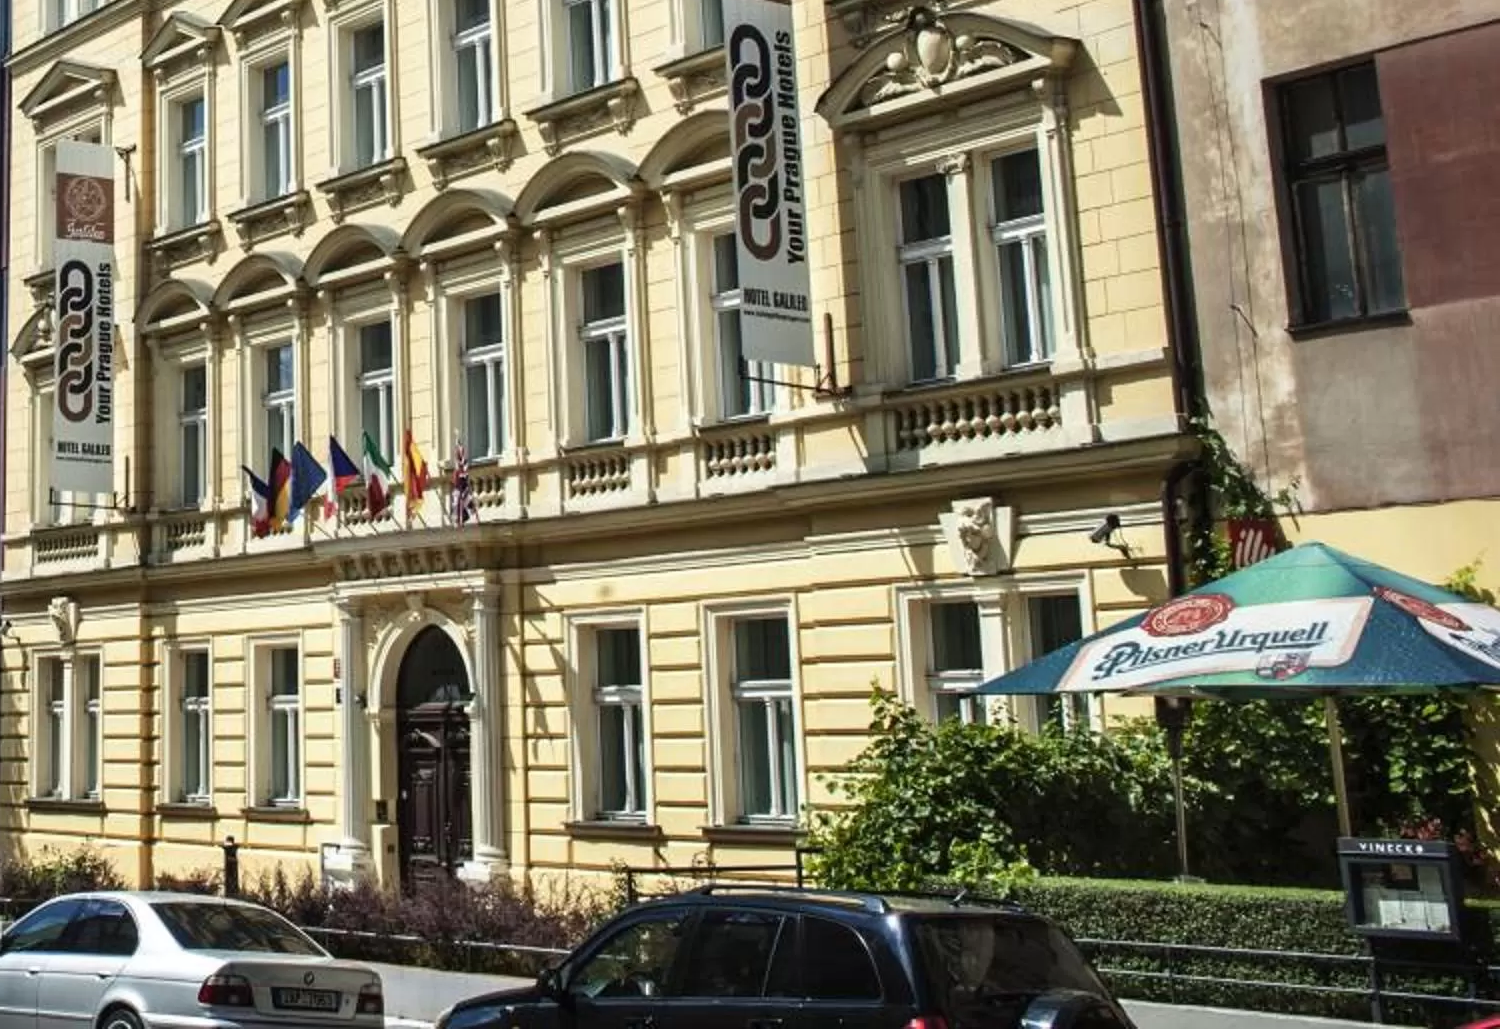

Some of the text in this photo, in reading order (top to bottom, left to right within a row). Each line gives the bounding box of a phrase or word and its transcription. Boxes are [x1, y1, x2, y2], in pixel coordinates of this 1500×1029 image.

[774, 31, 805, 264] Your Prague Hotels
[743, 287, 771, 307] HOTEL
[96, 262, 112, 423] Your Prague Hotels
[57, 441, 79, 454] HOTEL
[1092, 621, 1329, 681] Pilsner Urquell
